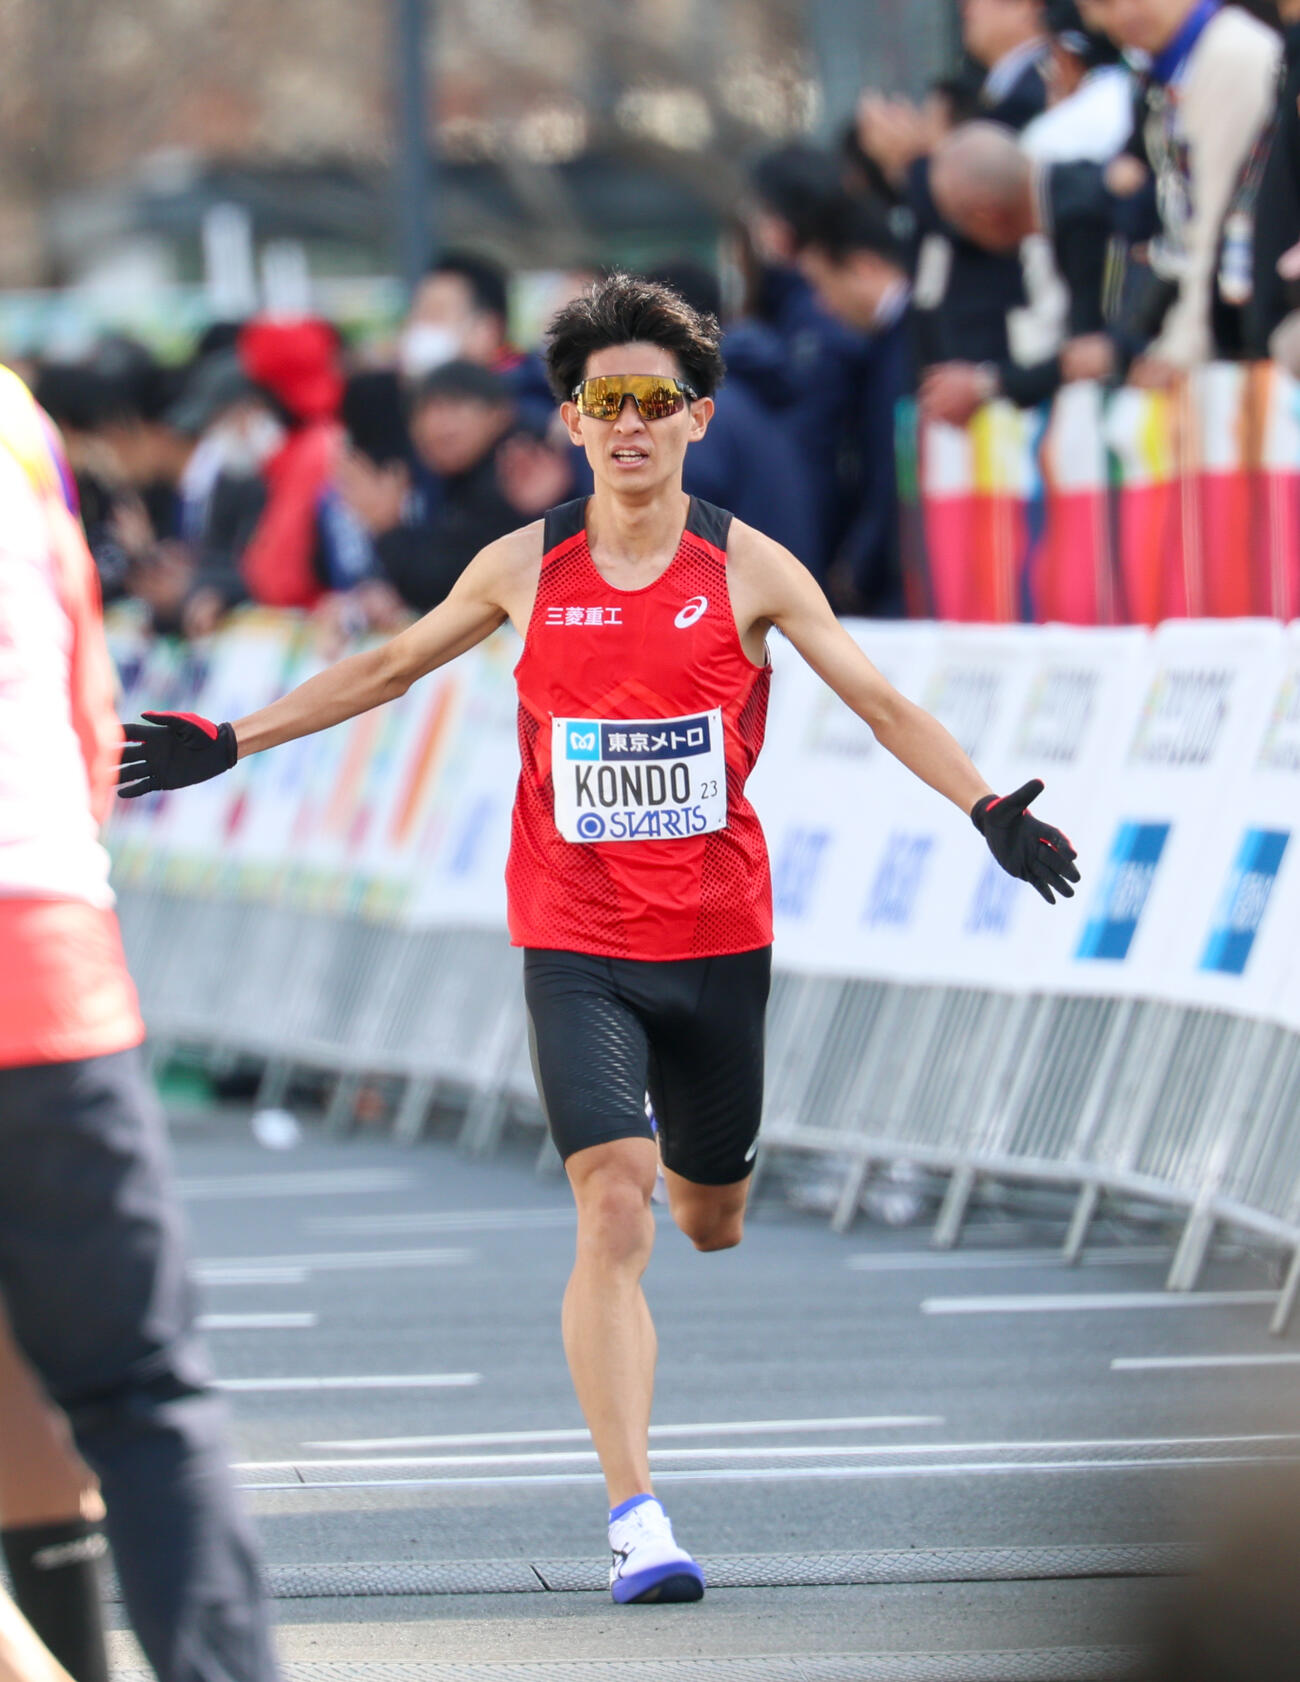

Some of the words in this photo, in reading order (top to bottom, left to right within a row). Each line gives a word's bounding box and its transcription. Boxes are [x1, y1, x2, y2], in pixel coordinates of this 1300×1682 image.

[545, 606, 623, 626] 三菱重工
[608, 727, 704, 752] 東京メトロ
[575, 763, 690, 807] KONDO
[701, 780, 719, 799] 23
